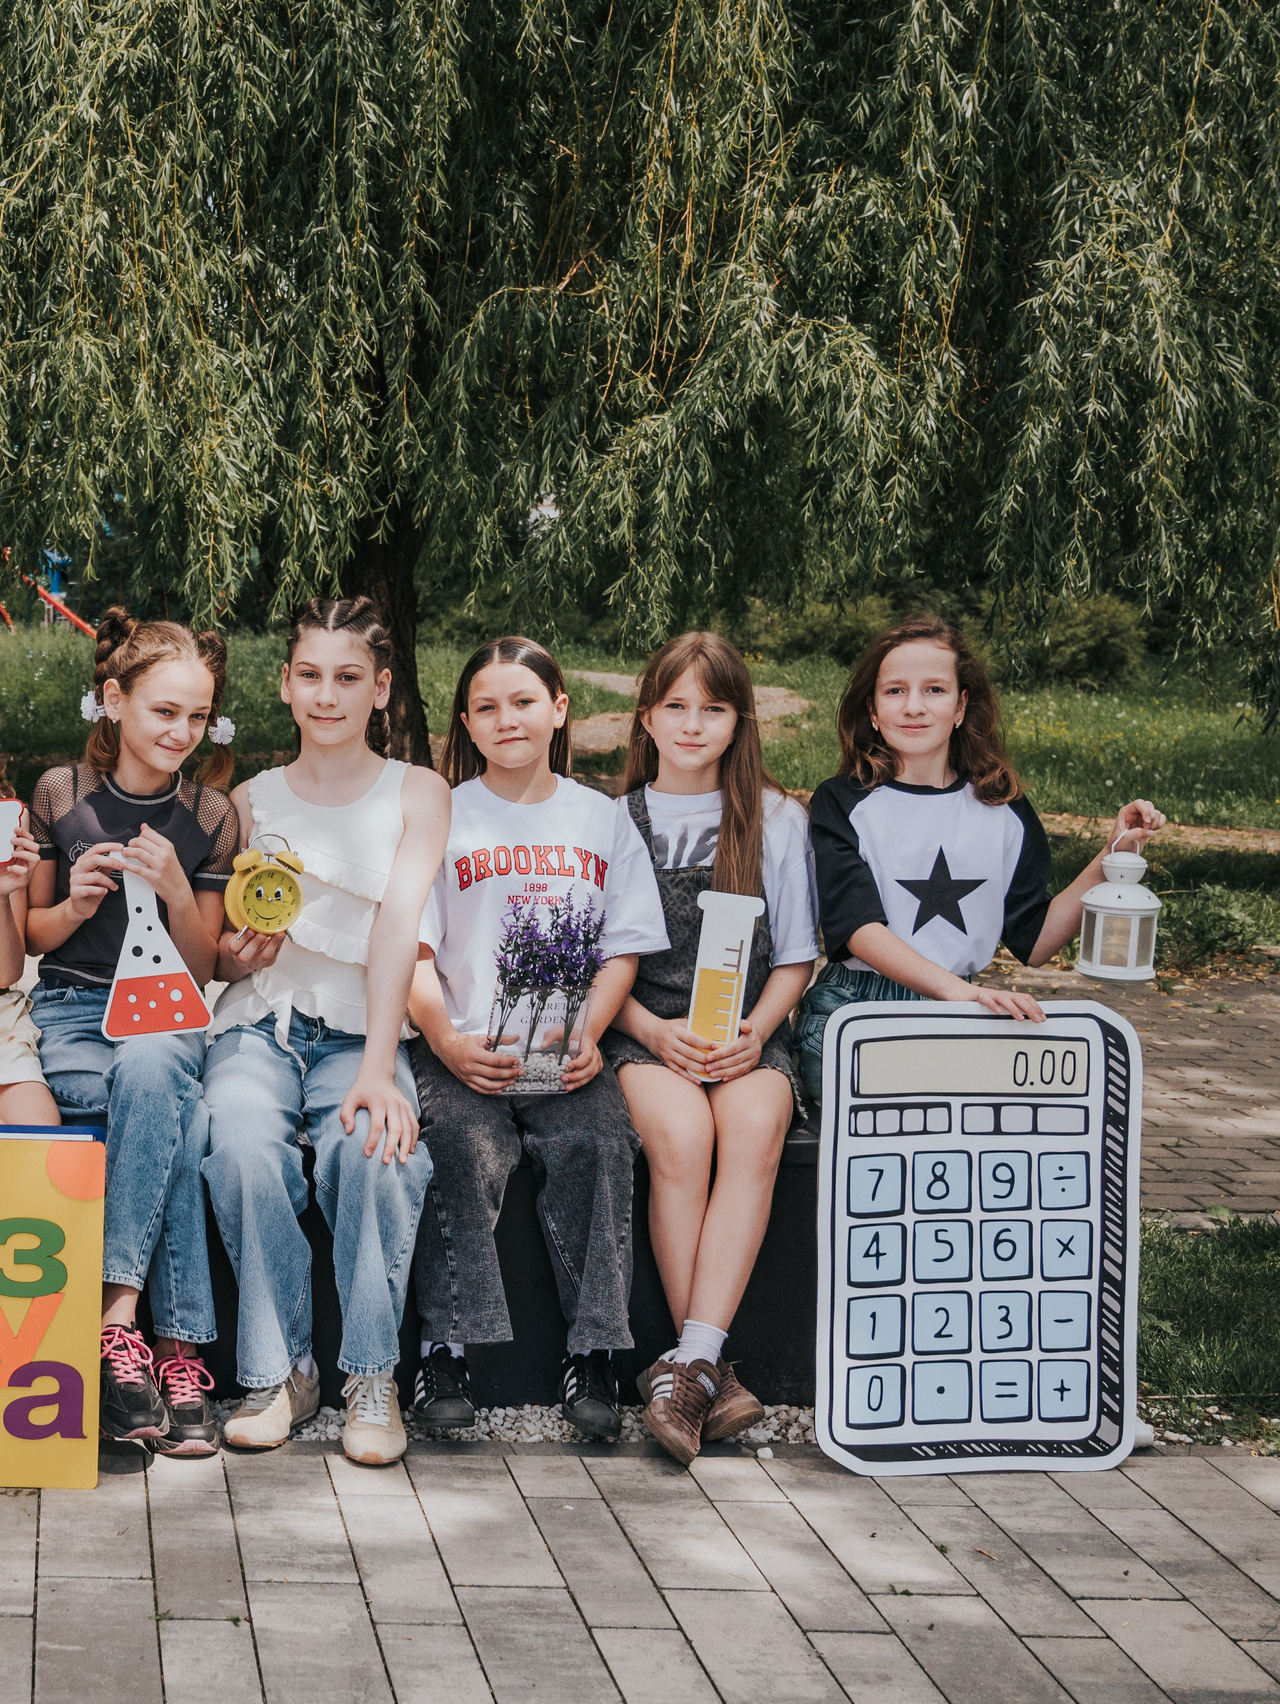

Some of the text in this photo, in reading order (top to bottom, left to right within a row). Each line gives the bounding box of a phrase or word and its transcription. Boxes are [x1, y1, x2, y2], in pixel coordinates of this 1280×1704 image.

[455, 845, 608, 891] BROOKLYN
[507, 895, 563, 905] NEW YORK
[523, 883, 548, 892] 1898
[1013, 1049, 1077, 1087] 0.00
[867, 1168, 885, 1202] 7
[926, 1160, 950, 1201] 8
[991, 1162, 1016, 1200] 9
[862, 1230, 888, 1271] 4
[932, 1228, 955, 1263] 5
[993, 1227, 1017, 1262] 6
[869, 1311, 877, 1341] 1
[933, 1306, 954, 1339] 2
[996, 1304, 1013, 1340] 3
[867, 1374, 884, 1412] 0
